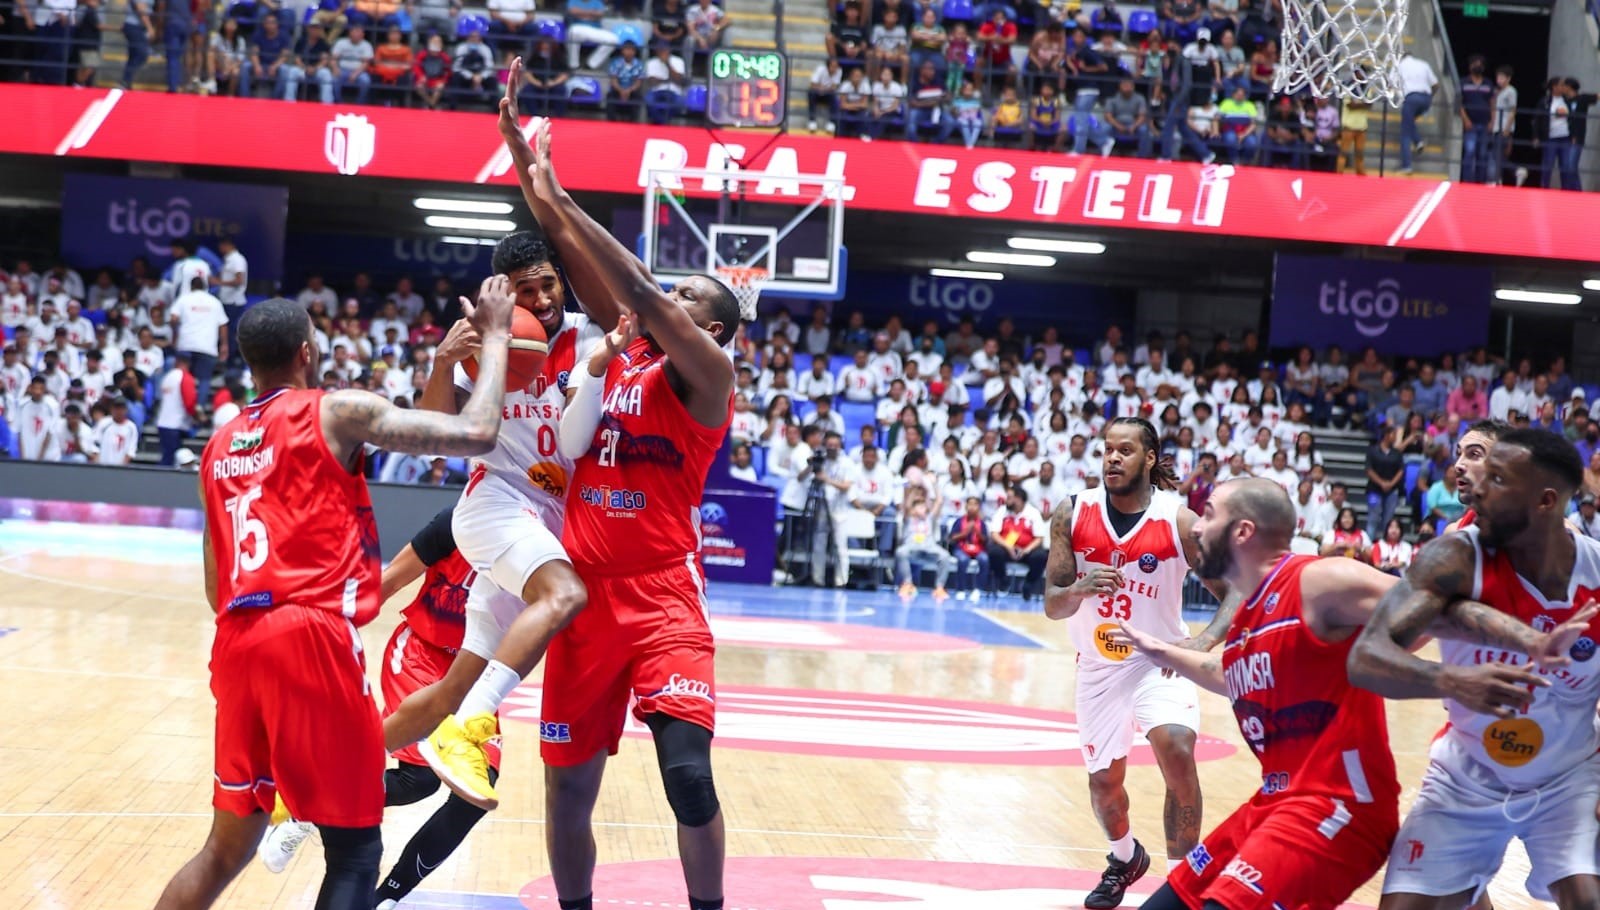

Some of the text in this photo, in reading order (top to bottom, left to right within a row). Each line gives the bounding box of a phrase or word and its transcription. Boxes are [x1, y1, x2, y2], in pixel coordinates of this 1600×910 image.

[714, 52, 780, 80] 07:48
[740, 79, 779, 121] 12
[638, 138, 1235, 227] REAL ESTELÍ
[537, 424, 557, 457] 0
[598, 428, 620, 467] 21
[213, 446, 275, 480] ROBINSON
[225, 485, 269, 580] 15
[1097, 593, 1132, 621] 33
[662, 673, 711, 696] Secco
[540, 722, 570, 737] BSE
[1490, 727, 1518, 742] uc
